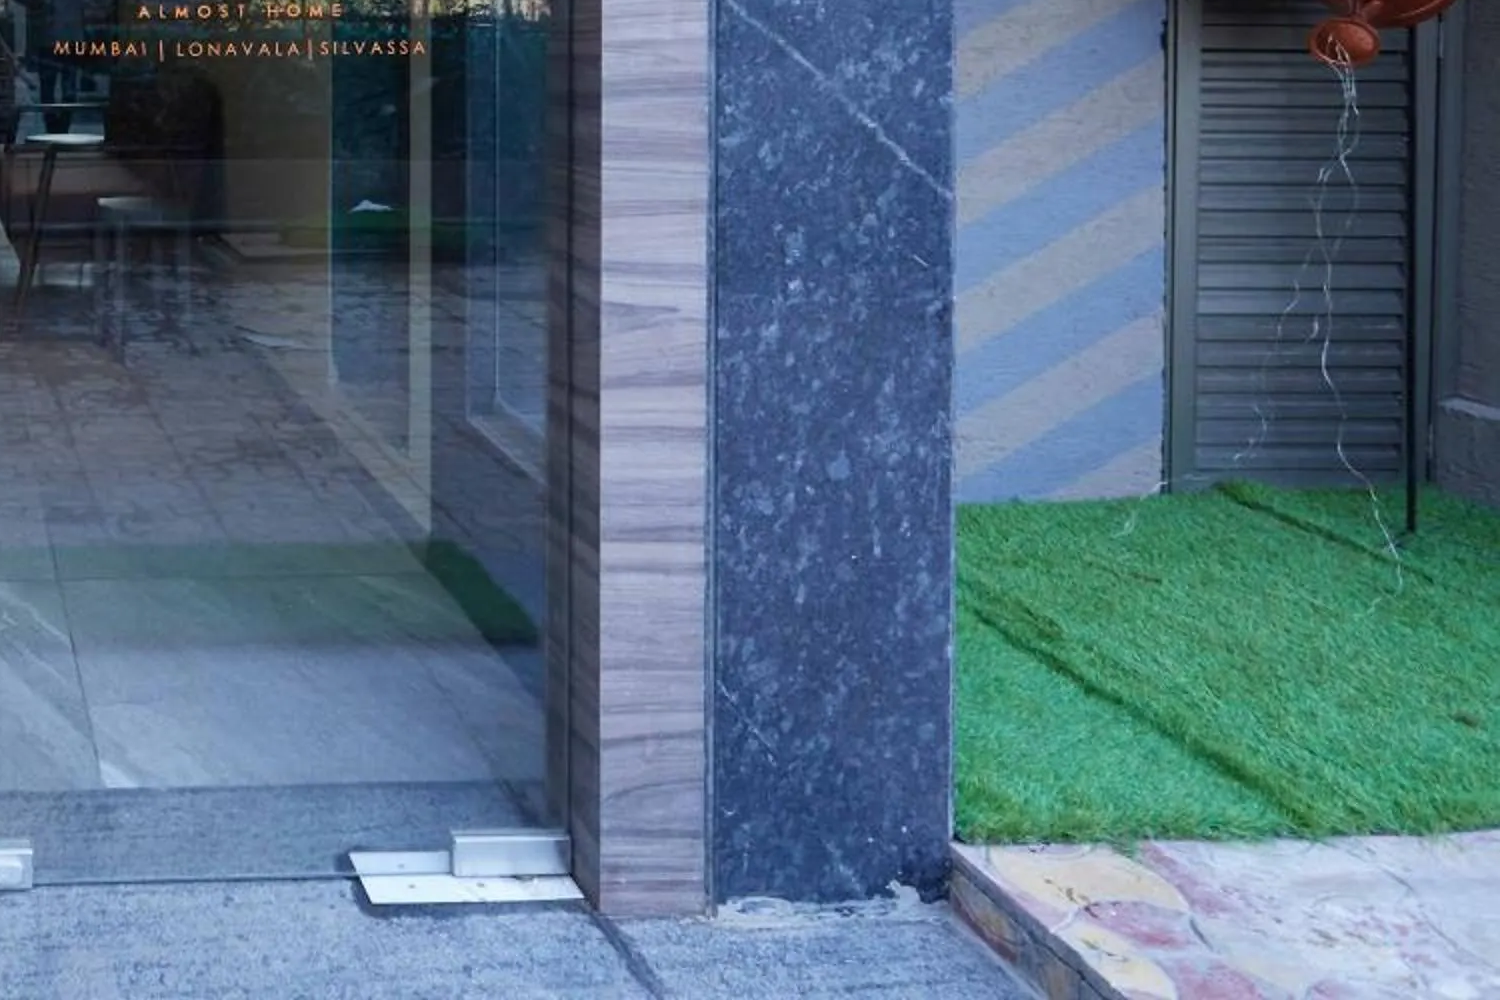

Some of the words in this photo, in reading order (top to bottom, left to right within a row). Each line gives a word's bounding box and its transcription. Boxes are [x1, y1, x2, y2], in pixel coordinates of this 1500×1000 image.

[136, 3, 248, 20] ALMOST
[266, 2, 344, 19] HOME
[52, 39, 148, 57] MUMBAI
